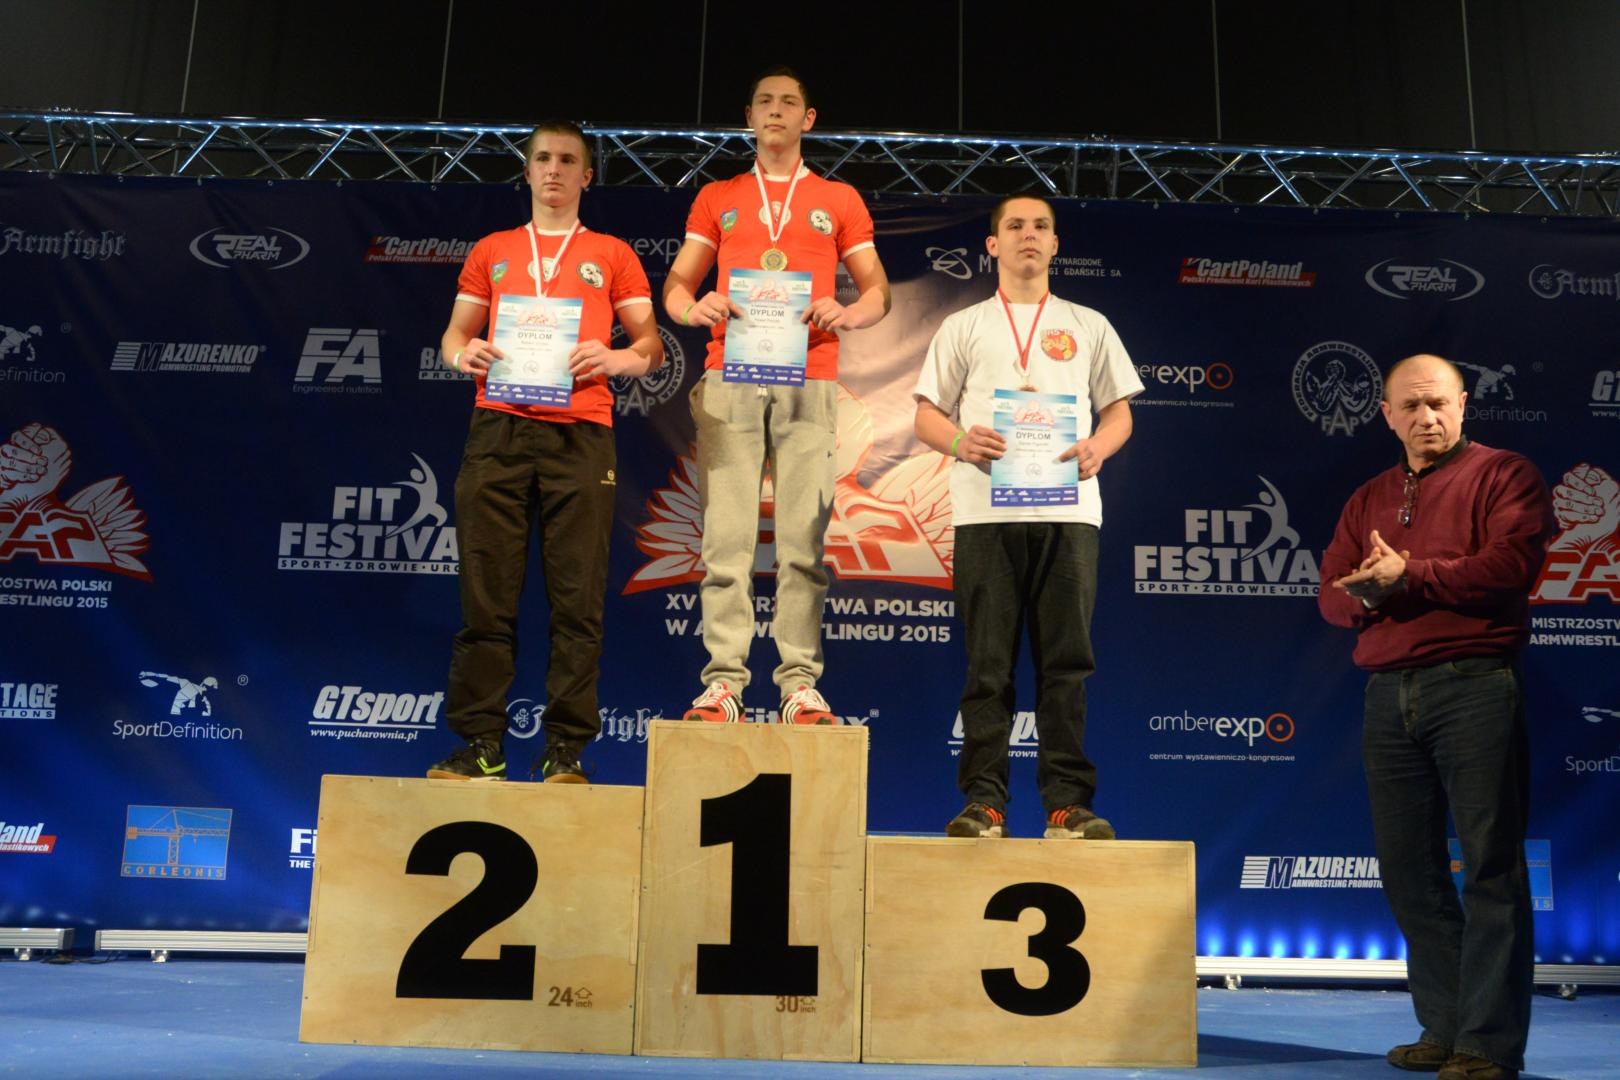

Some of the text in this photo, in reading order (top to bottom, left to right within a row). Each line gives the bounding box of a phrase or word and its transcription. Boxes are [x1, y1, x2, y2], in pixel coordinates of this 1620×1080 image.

[212, 234, 282, 260] REAL
[232, 250, 280, 261] PHARM
[1197, 258, 1303, 280] CartPoland
[1386, 266, 1457, 291] REAL
[1410, 281, 1456, 292] PHARM
[750, 308, 785, 317] DYPLOM
[517, 331, 553, 340] DYPLOM
[134, 342, 259, 371] MAZURENKO
[1015, 431, 1051, 440] DYPLOM
[332, 486, 402, 521] FIT
[1185, 509, 1253, 544] FIT
[61, 579, 112, 592] POLSKI
[76, 596, 109, 608] 2015
[665, 593, 698, 611] XV
[873, 599, 955, 618] POLSKI
[900, 626, 951, 643] 2015
[312, 685, 445, 724] GTsport
[112, 719, 243, 740] SportDefinition
[310, 728, 419, 742] www.pucharownia.pl
[1149, 710, 1295, 747] amberexpo
[1149, 753, 1183, 761] centrum
[122, 866, 223, 878] CORLEONIS
[696, 773, 819, 996] 1
[395, 820, 539, 1001] 2
[981, 882, 1091, 1017] 3
[548, 986, 593, 1008] 24 inch
[775, 994, 816, 1014] 30 inch
